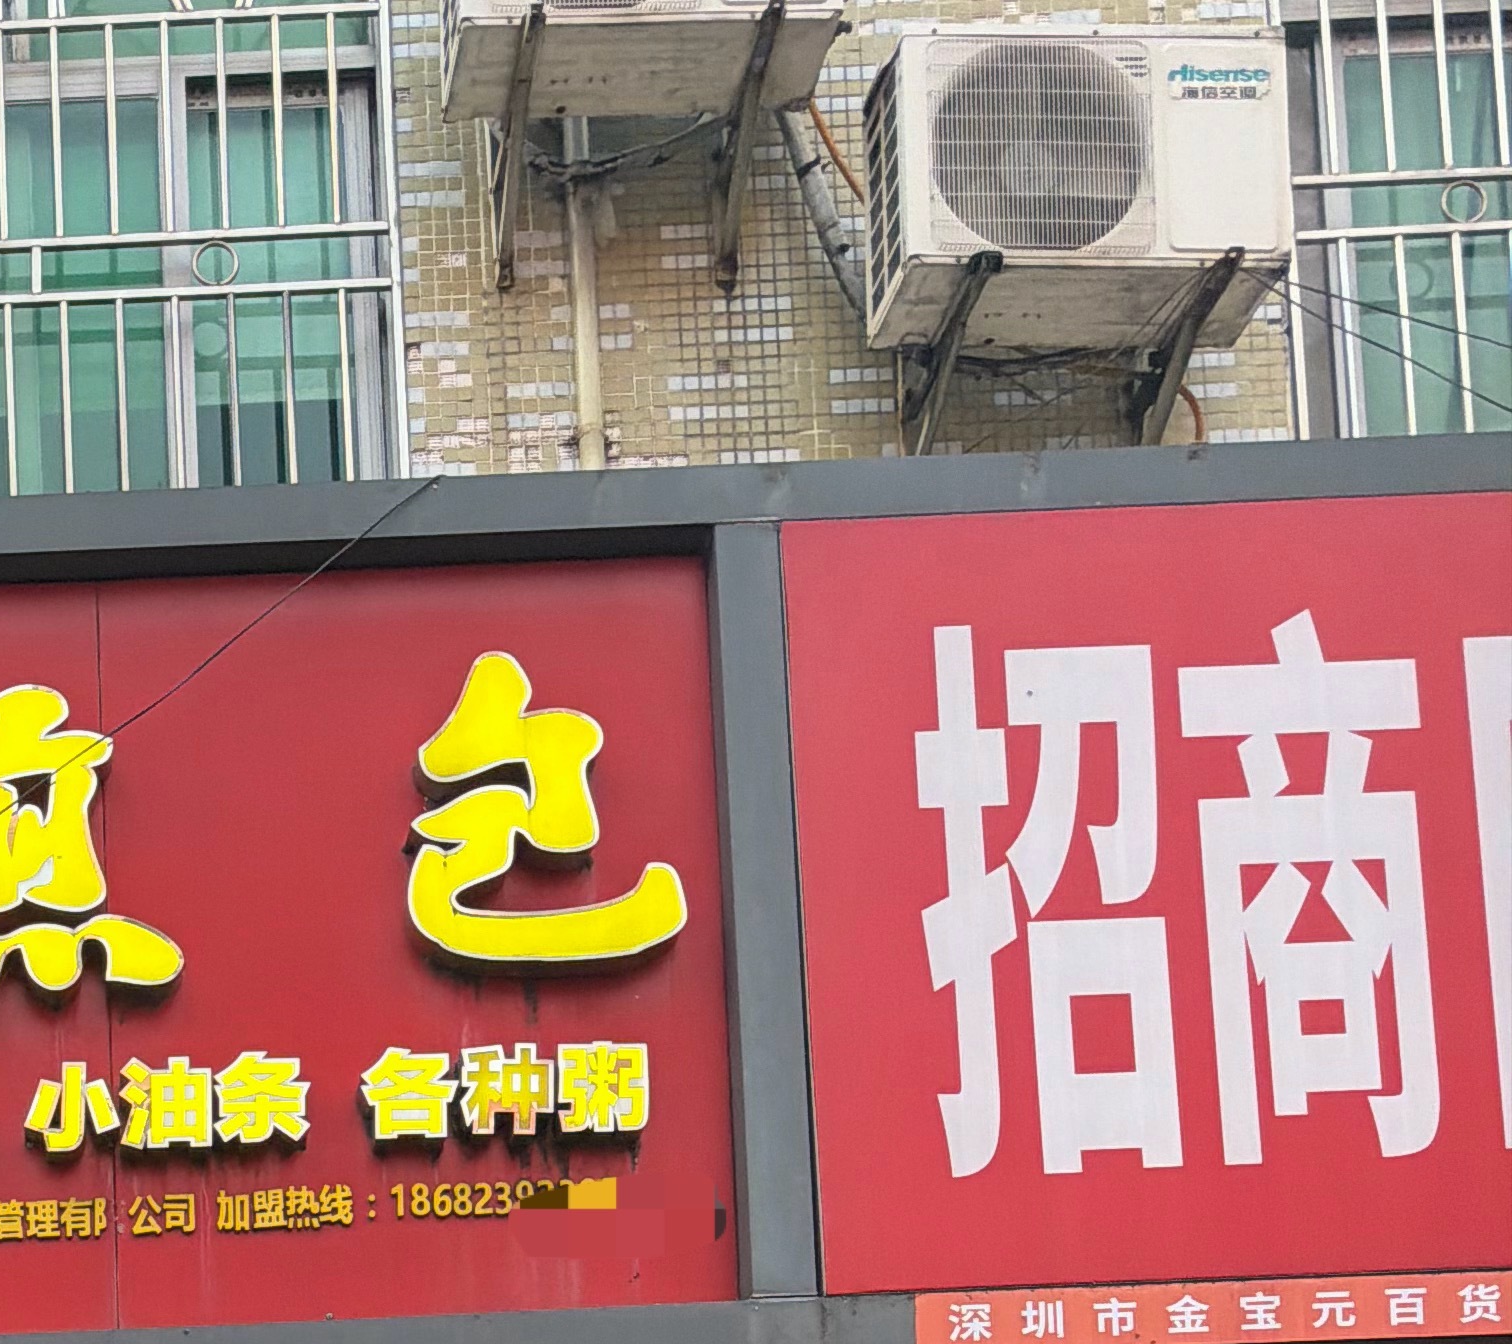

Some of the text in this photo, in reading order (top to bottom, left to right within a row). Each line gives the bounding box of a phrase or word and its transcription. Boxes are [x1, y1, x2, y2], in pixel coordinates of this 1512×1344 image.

[1168, 64, 1270, 82] Hisense
[915, 608, 1512, 1178] 招商
[25, 1051, 311, 1152] 小油条
[360, 1040, 649, 1140] 各种粥
[949, 1284, 1503, 1343] 深圳市金宝元百货
